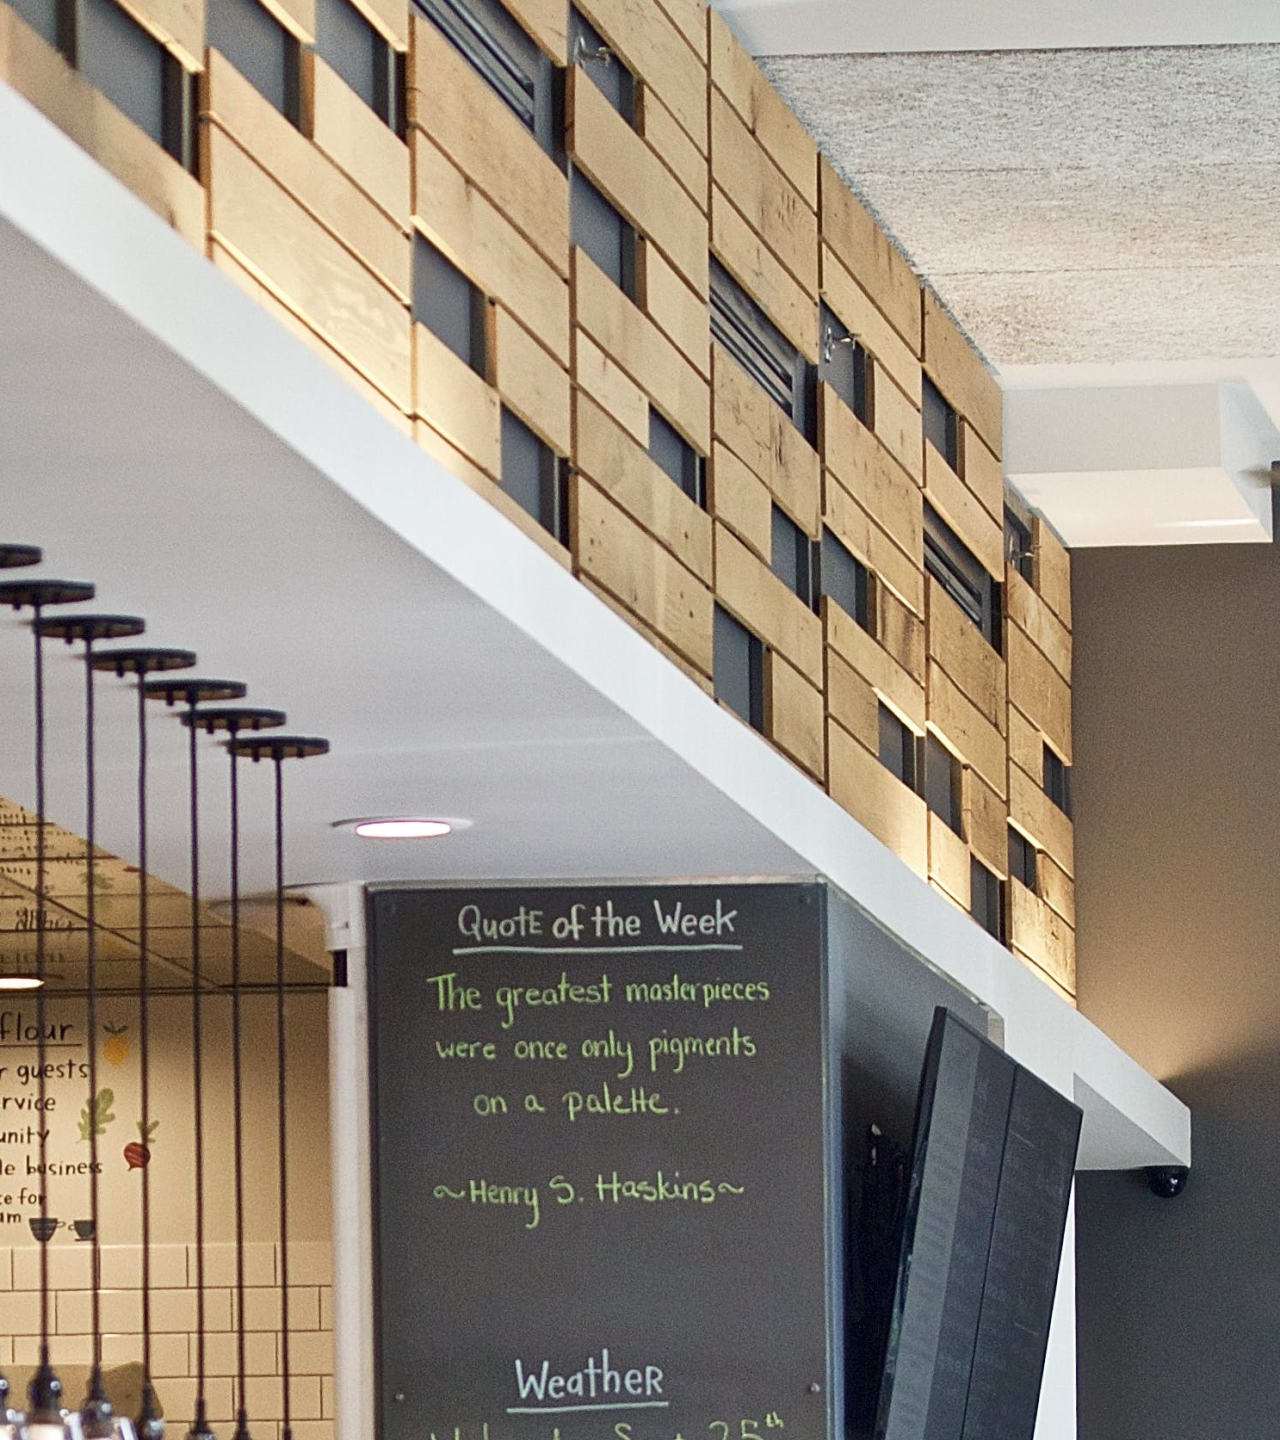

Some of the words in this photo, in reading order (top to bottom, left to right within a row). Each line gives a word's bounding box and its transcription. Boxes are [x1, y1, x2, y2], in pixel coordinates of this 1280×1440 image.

[552, 903, 586, 941] of
[591, 900, 642, 938] the
[654, 899, 738, 937] Week
[426, 973, 482, 1011] The
[496, 971, 612, 1029] greatest
[435, 1040, 496, 1060] were
[514, 1040, 568, 1060] once
[581, 1029, 634, 1079] only
[649, 1027, 757, 1073] pigments
[17, 1058, 92, 1086] guests
[474, 1092, 508, 1116] on
[524, 1094, 545, 1112] a
[562, 1081, 681, 1121] palette.
[26, 1154, 104, 1176] business
[16, 1186, 48, 1207] for
[549, 1175, 585, 1203] S.
